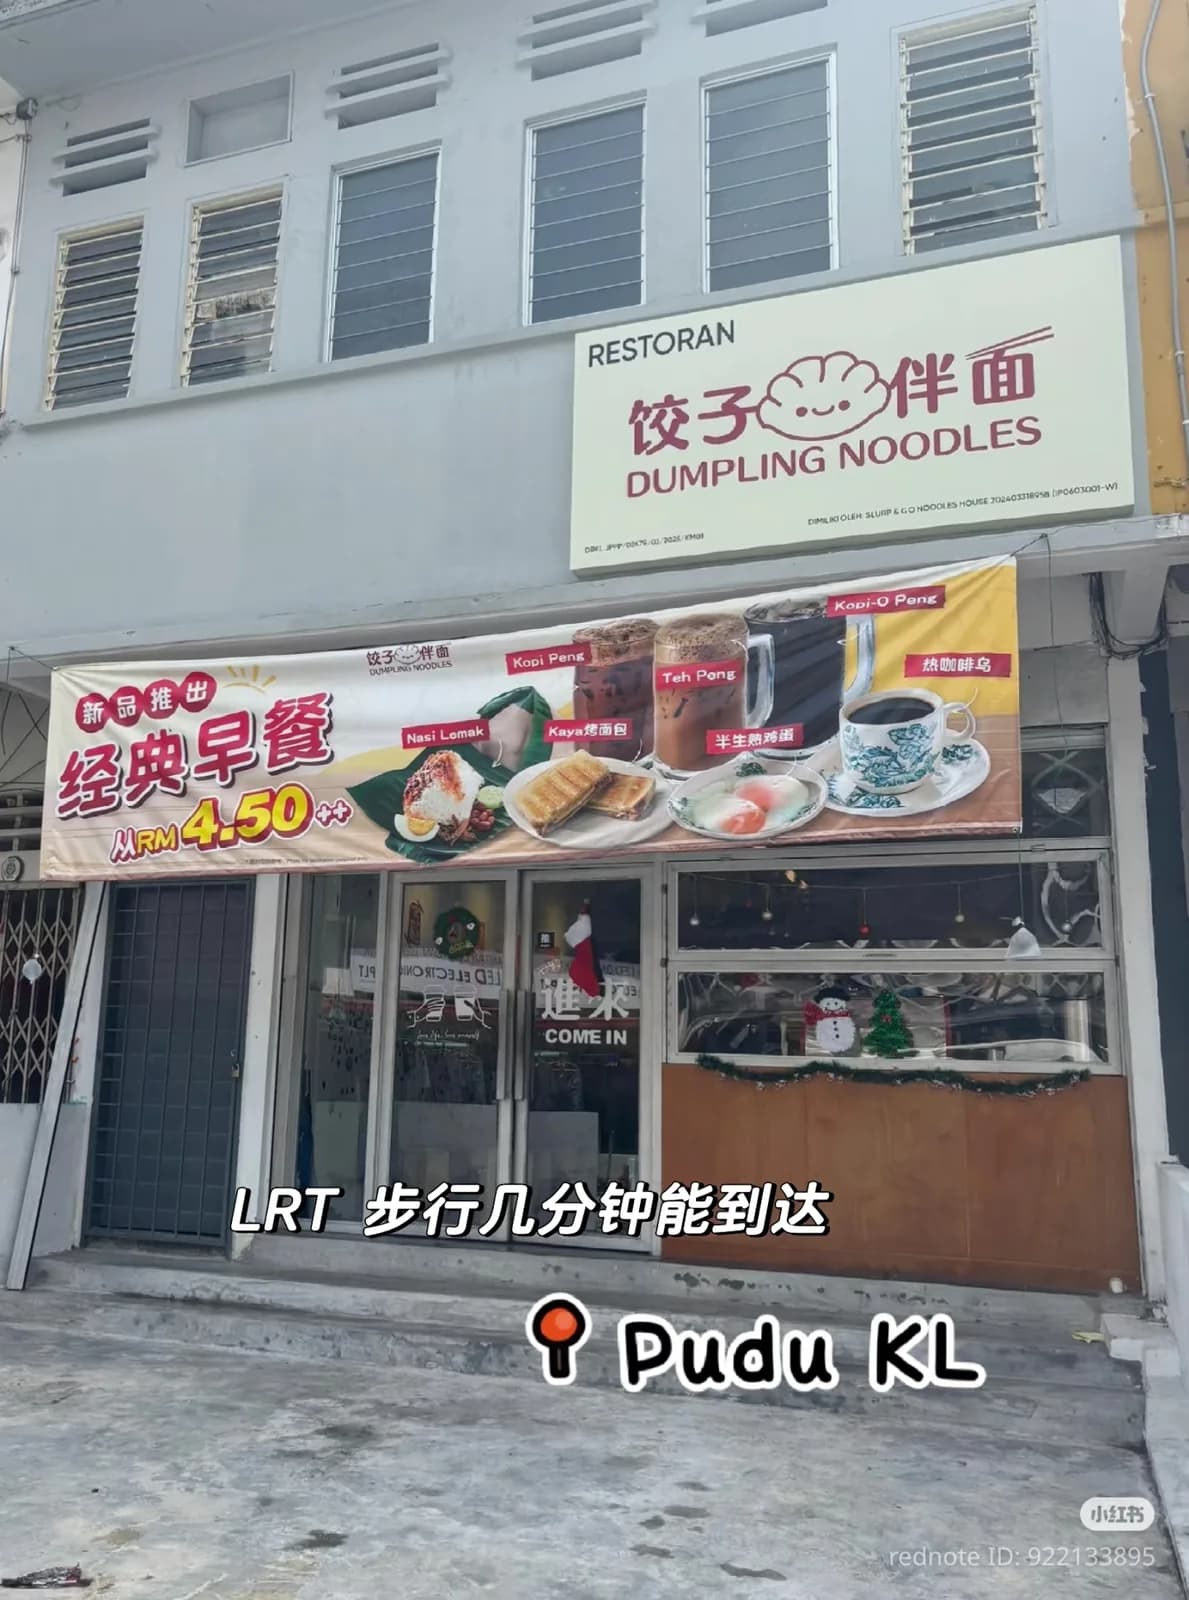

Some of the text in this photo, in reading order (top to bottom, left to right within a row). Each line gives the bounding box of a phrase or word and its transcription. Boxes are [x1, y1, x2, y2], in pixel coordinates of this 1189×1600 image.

[588, 320, 734, 367] RESTORAN
[628, 342, 1038, 455] 饺子 伴面
[627, 416, 1041, 498] DUMPLING NOODLES
[917, 501, 958, 513] NOODLES
[960, 497, 988, 508] HOUSE
[834, 593, 938, 611] Kopi-O Peng
[366, 645, 450, 666] 饺子 伴面
[513, 651, 585, 669] Kopi Peng
[922, 657, 991, 673] 热咖啡乌
[369, 660, 453, 676] DUMPLING NOODLES
[662, 668, 736, 683] Teh Peng
[83, 681, 207, 724] 新品推出
[407, 725, 484, 744] Nasi Lemak
[715, 728, 794, 749] 半生熟鸡蛋
[57, 692, 334, 819] 经典早餐
[545, 1029, 627, 1045] COME IN
